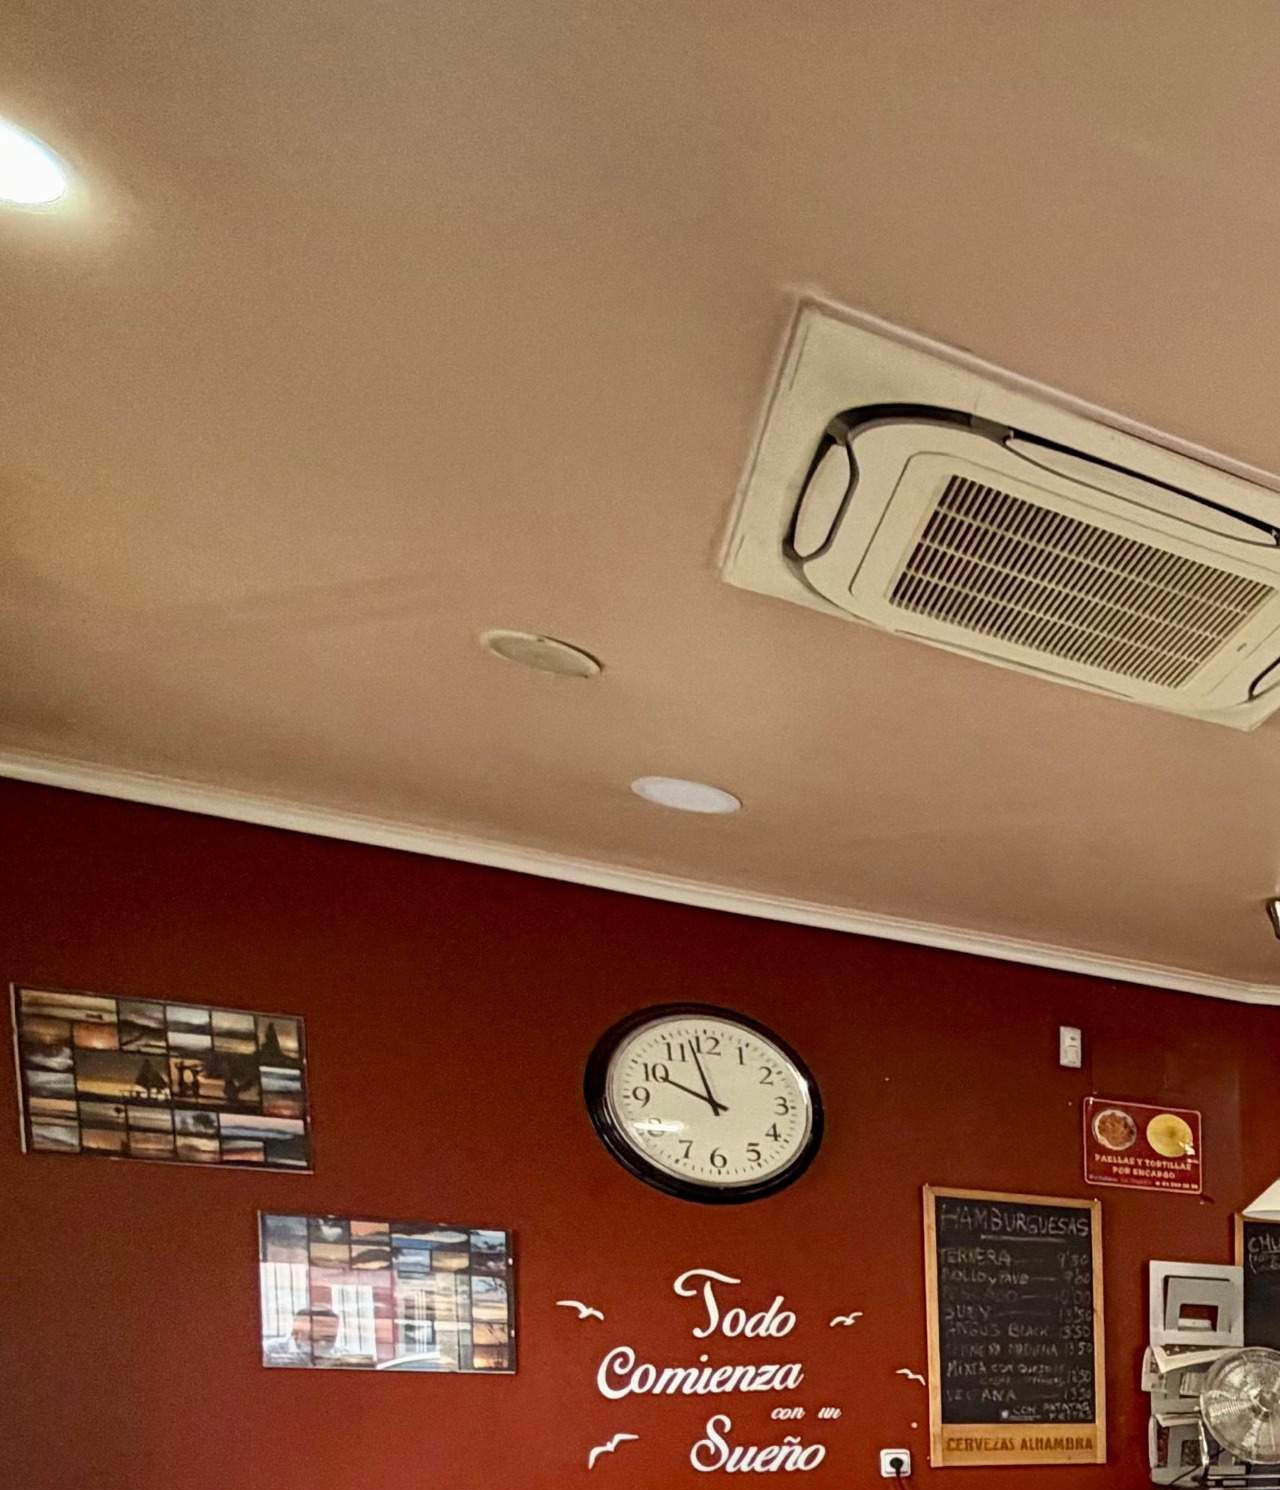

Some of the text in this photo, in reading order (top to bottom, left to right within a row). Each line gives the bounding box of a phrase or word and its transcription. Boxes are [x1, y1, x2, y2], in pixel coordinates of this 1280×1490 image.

[666, 1042, 687, 1062] 11
[695, 1035, 722, 1056] 12
[738, 1046, 746, 1066] 1
[642, 1062, 669, 1083] 10
[759, 1066, 774, 1086] 2
[632, 1086, 650, 1108] 9
[775, 1096, 789, 1116] 3
[765, 1123, 782, 1142] 4
[678, 1140, 694, 1160] 7
[710, 1147, 728, 1169] 6
[746, 1142, 761, 1162] 5
[1095, 1153, 1192, 1171] PAELLAS Y TORTILLAS
[1112, 1166, 1175, 1179] POR ENCARGO
[940, 1203, 1090, 1237] HAMBURGUESAS
[940, 1247, 1012, 1267] TERNERA
[673, 1268, 797, 1339] Todo
[596, 1345, 805, 1400] Comienza
[770, 1406, 842, 1420] con un
[690, 1413, 827, 1473] Sueño
[946, 1436, 1094, 1452] CERVEZAS ALHAMBRA
